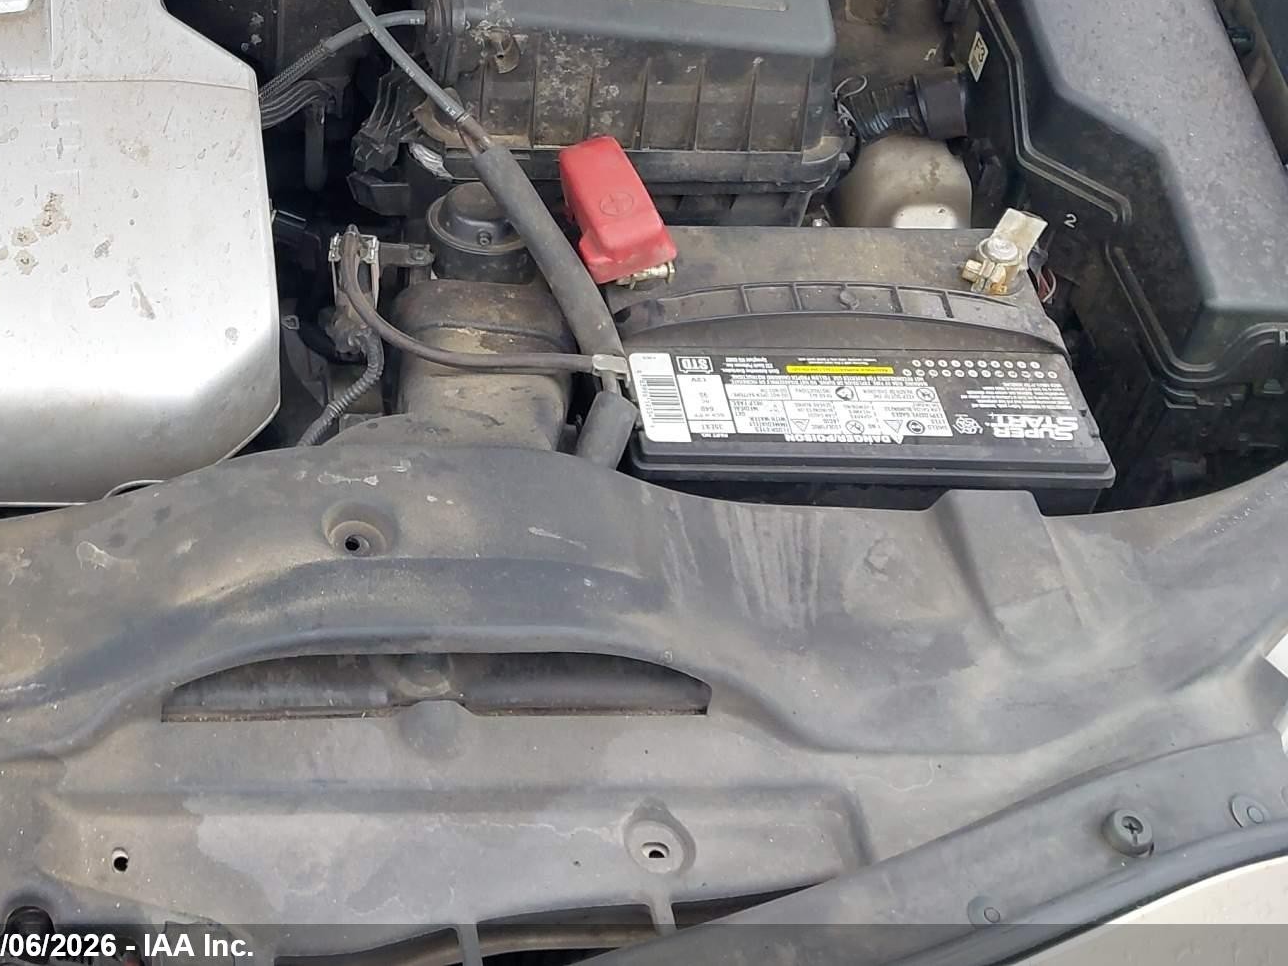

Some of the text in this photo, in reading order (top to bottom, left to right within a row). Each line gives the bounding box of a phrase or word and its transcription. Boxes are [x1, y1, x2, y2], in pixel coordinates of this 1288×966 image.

[681, 357, 709, 370] STD
[993, 415, 1079, 432] START
[993, 426, 1074, 441] SUPER
